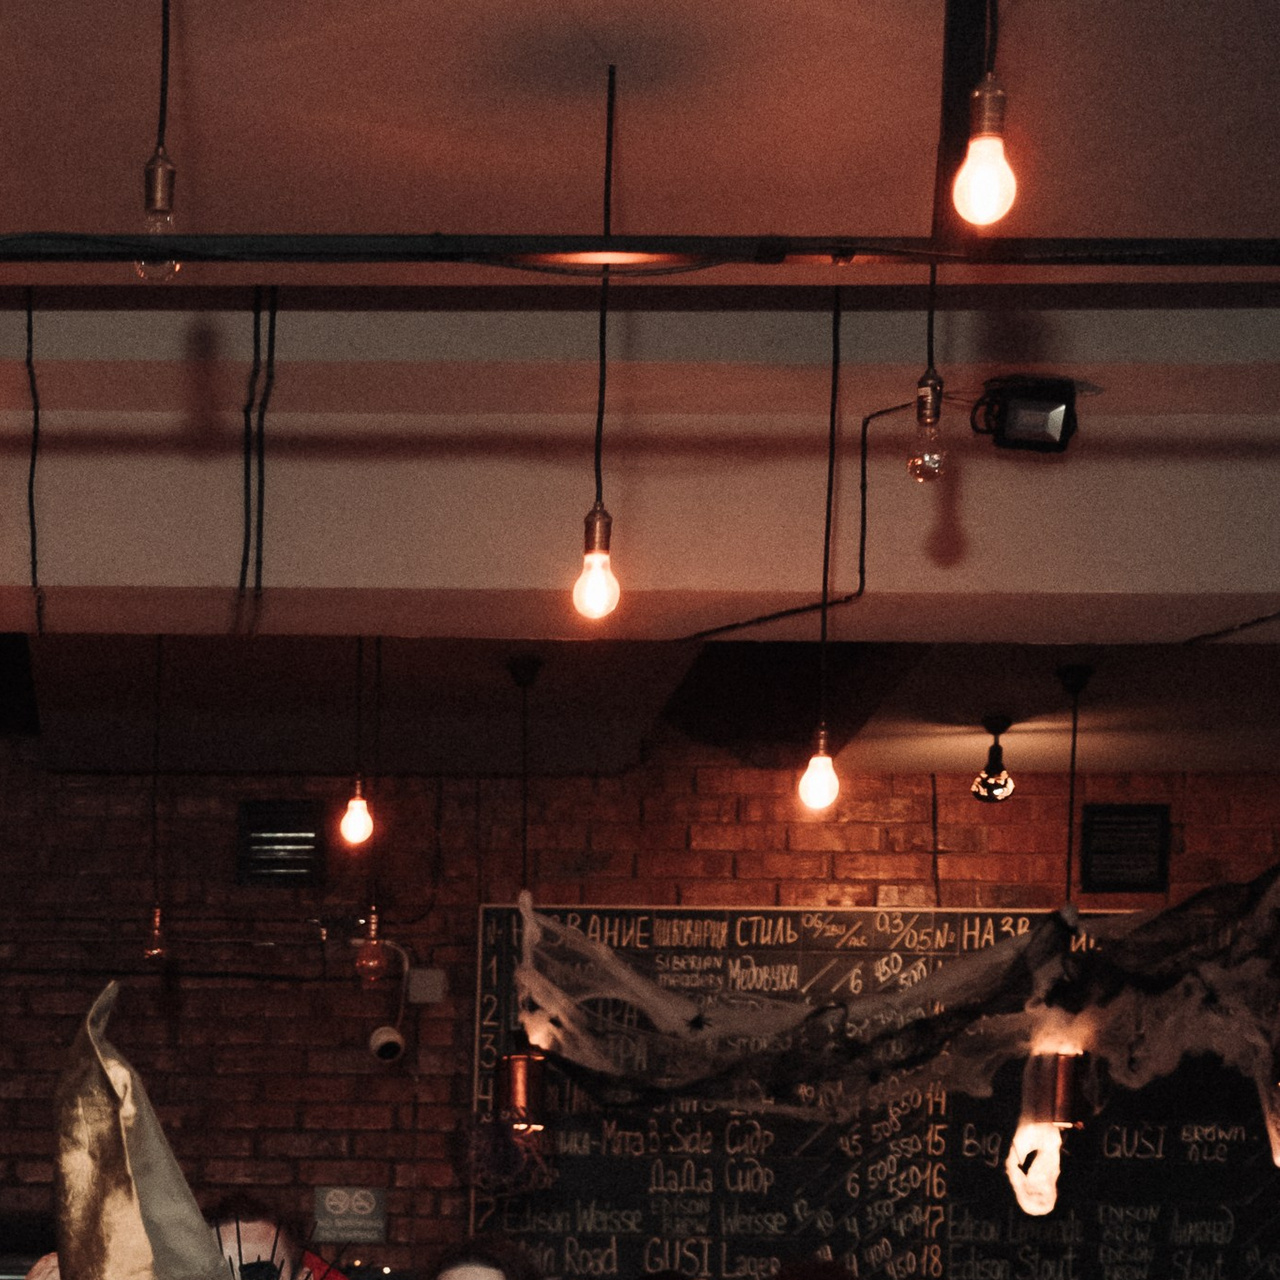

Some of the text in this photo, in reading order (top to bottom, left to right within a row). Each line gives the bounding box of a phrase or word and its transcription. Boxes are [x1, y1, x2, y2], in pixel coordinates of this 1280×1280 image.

[734, 915, 800, 947] СТИЛЬ
[484, 954, 498, 987] 1
[482, 994, 499, 1027] 2
[480, 1033, 498, 1069] 3
[925, 1080, 947, 1116] 14
[724, 1118, 776, 1157] Сидр
[925, 1123, 948, 1157] 15
[961, 1121, 1002, 1169] Big
[1102, 1124, 1167, 1160] GUSI
[647, 1158, 714, 1194] ДаДа
[724, 1156, 776, 1195] Сидр
[846, 1171, 861, 1199] 6
[924, 1161, 948, 1200] 16
[502, 1199, 571, 1233] Edison
[575, 1198, 643, 1234] Weisse
[719, 1199, 788, 1236] Weisse
[923, 1204, 946, 1239] 17
[563, 1234, 619, 1275] Road
[643, 1235, 713, 1278] GUSI
[920, 1243, 944, 1279] 18
